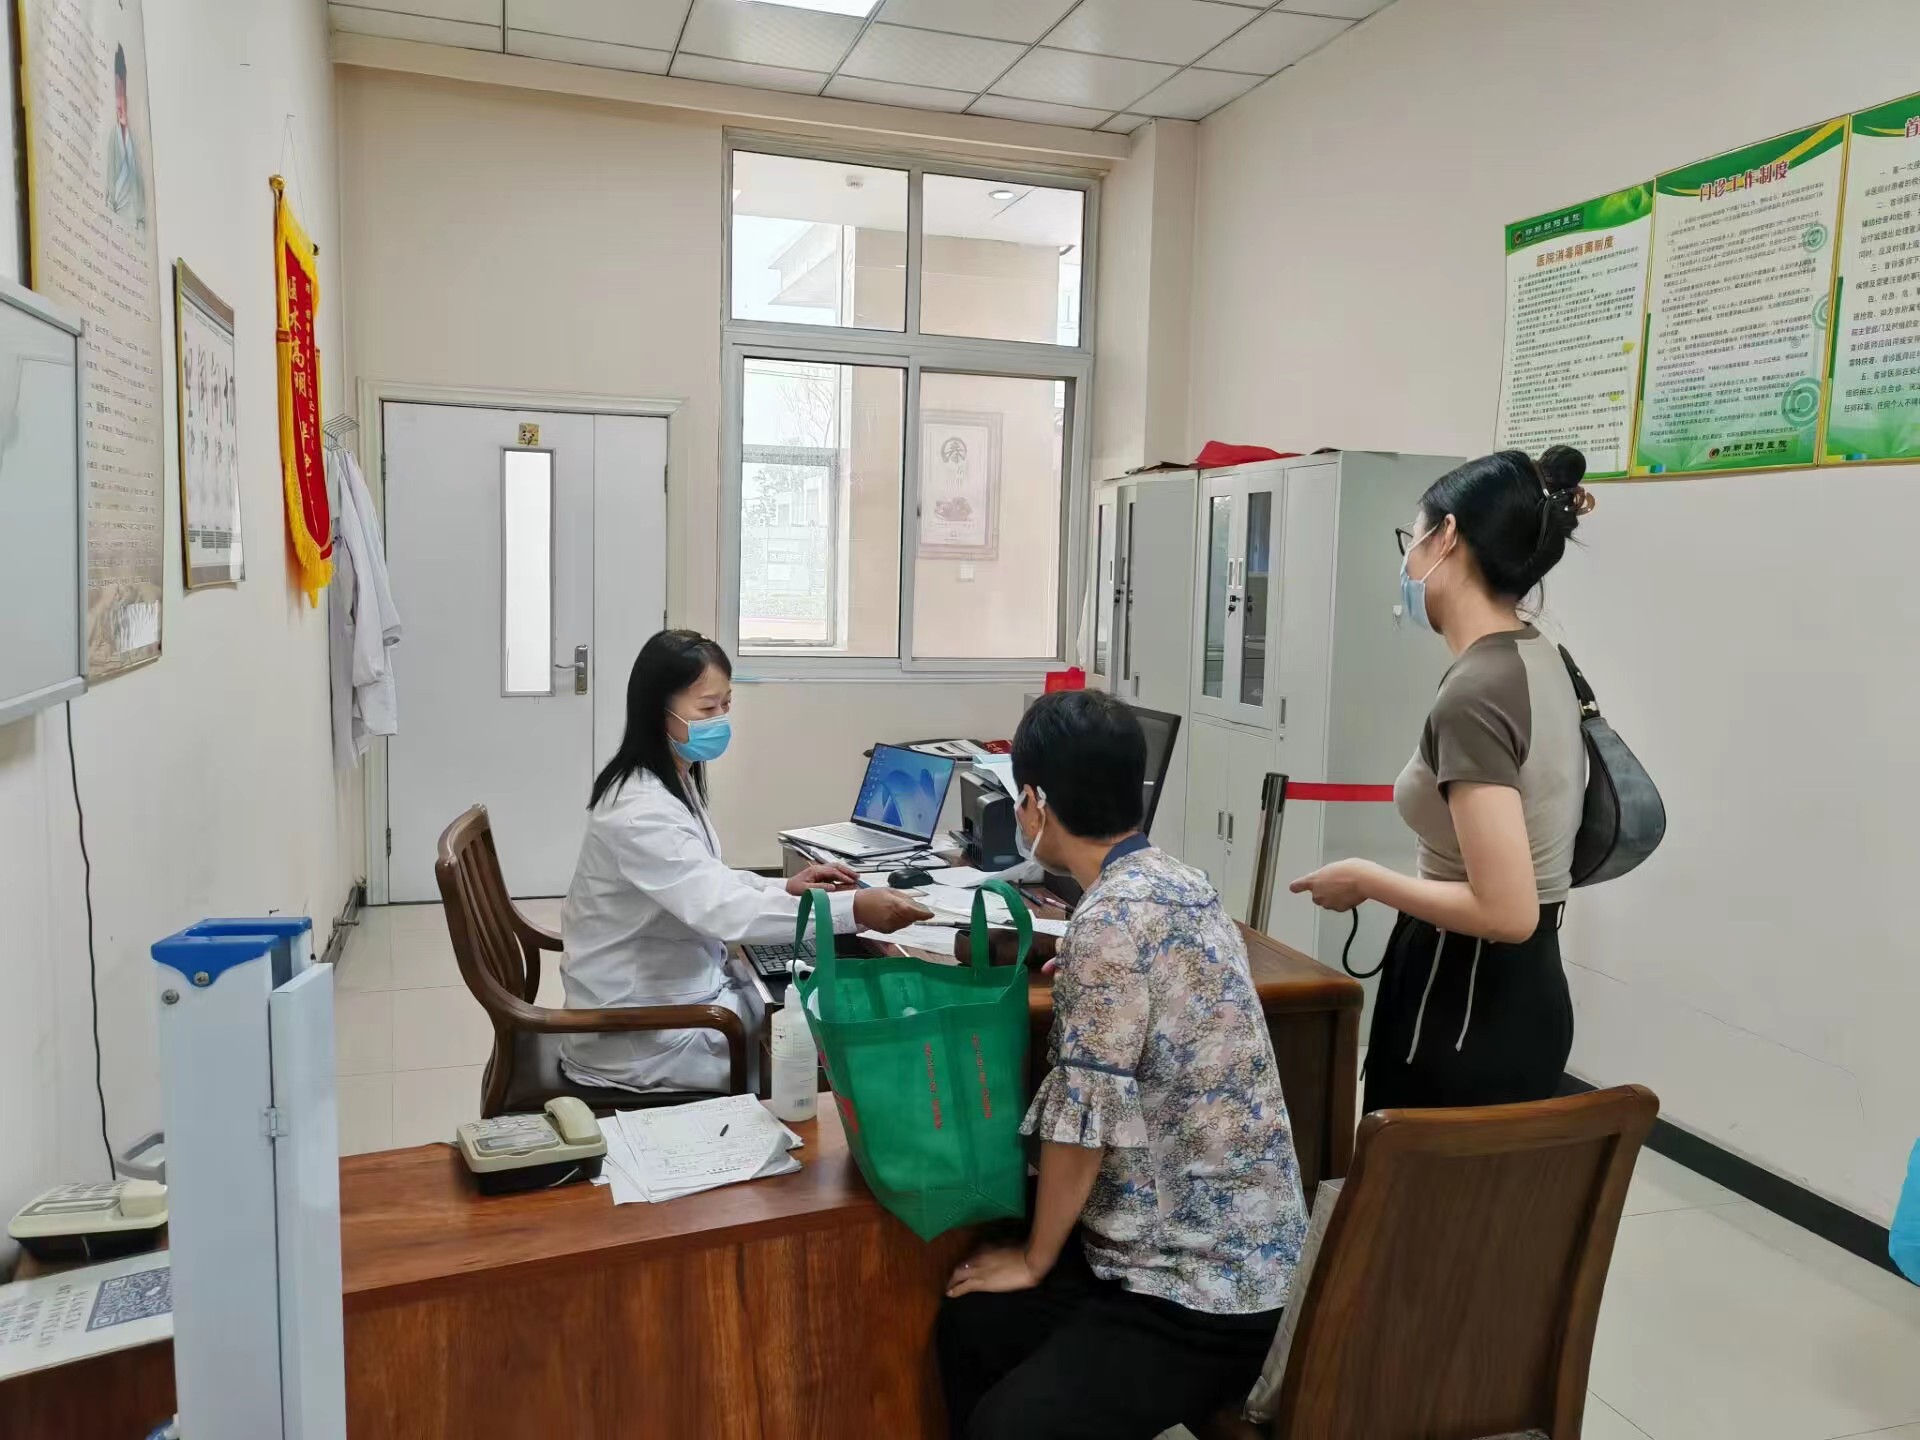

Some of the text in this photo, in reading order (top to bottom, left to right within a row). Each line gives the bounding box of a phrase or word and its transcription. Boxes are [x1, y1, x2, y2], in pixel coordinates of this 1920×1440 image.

[1904, 115, 1920, 139] 首
[1700, 160, 1789, 202] 门诊工作制度
[1536, 235, 1614, 267] 医院消毒隔离制度
